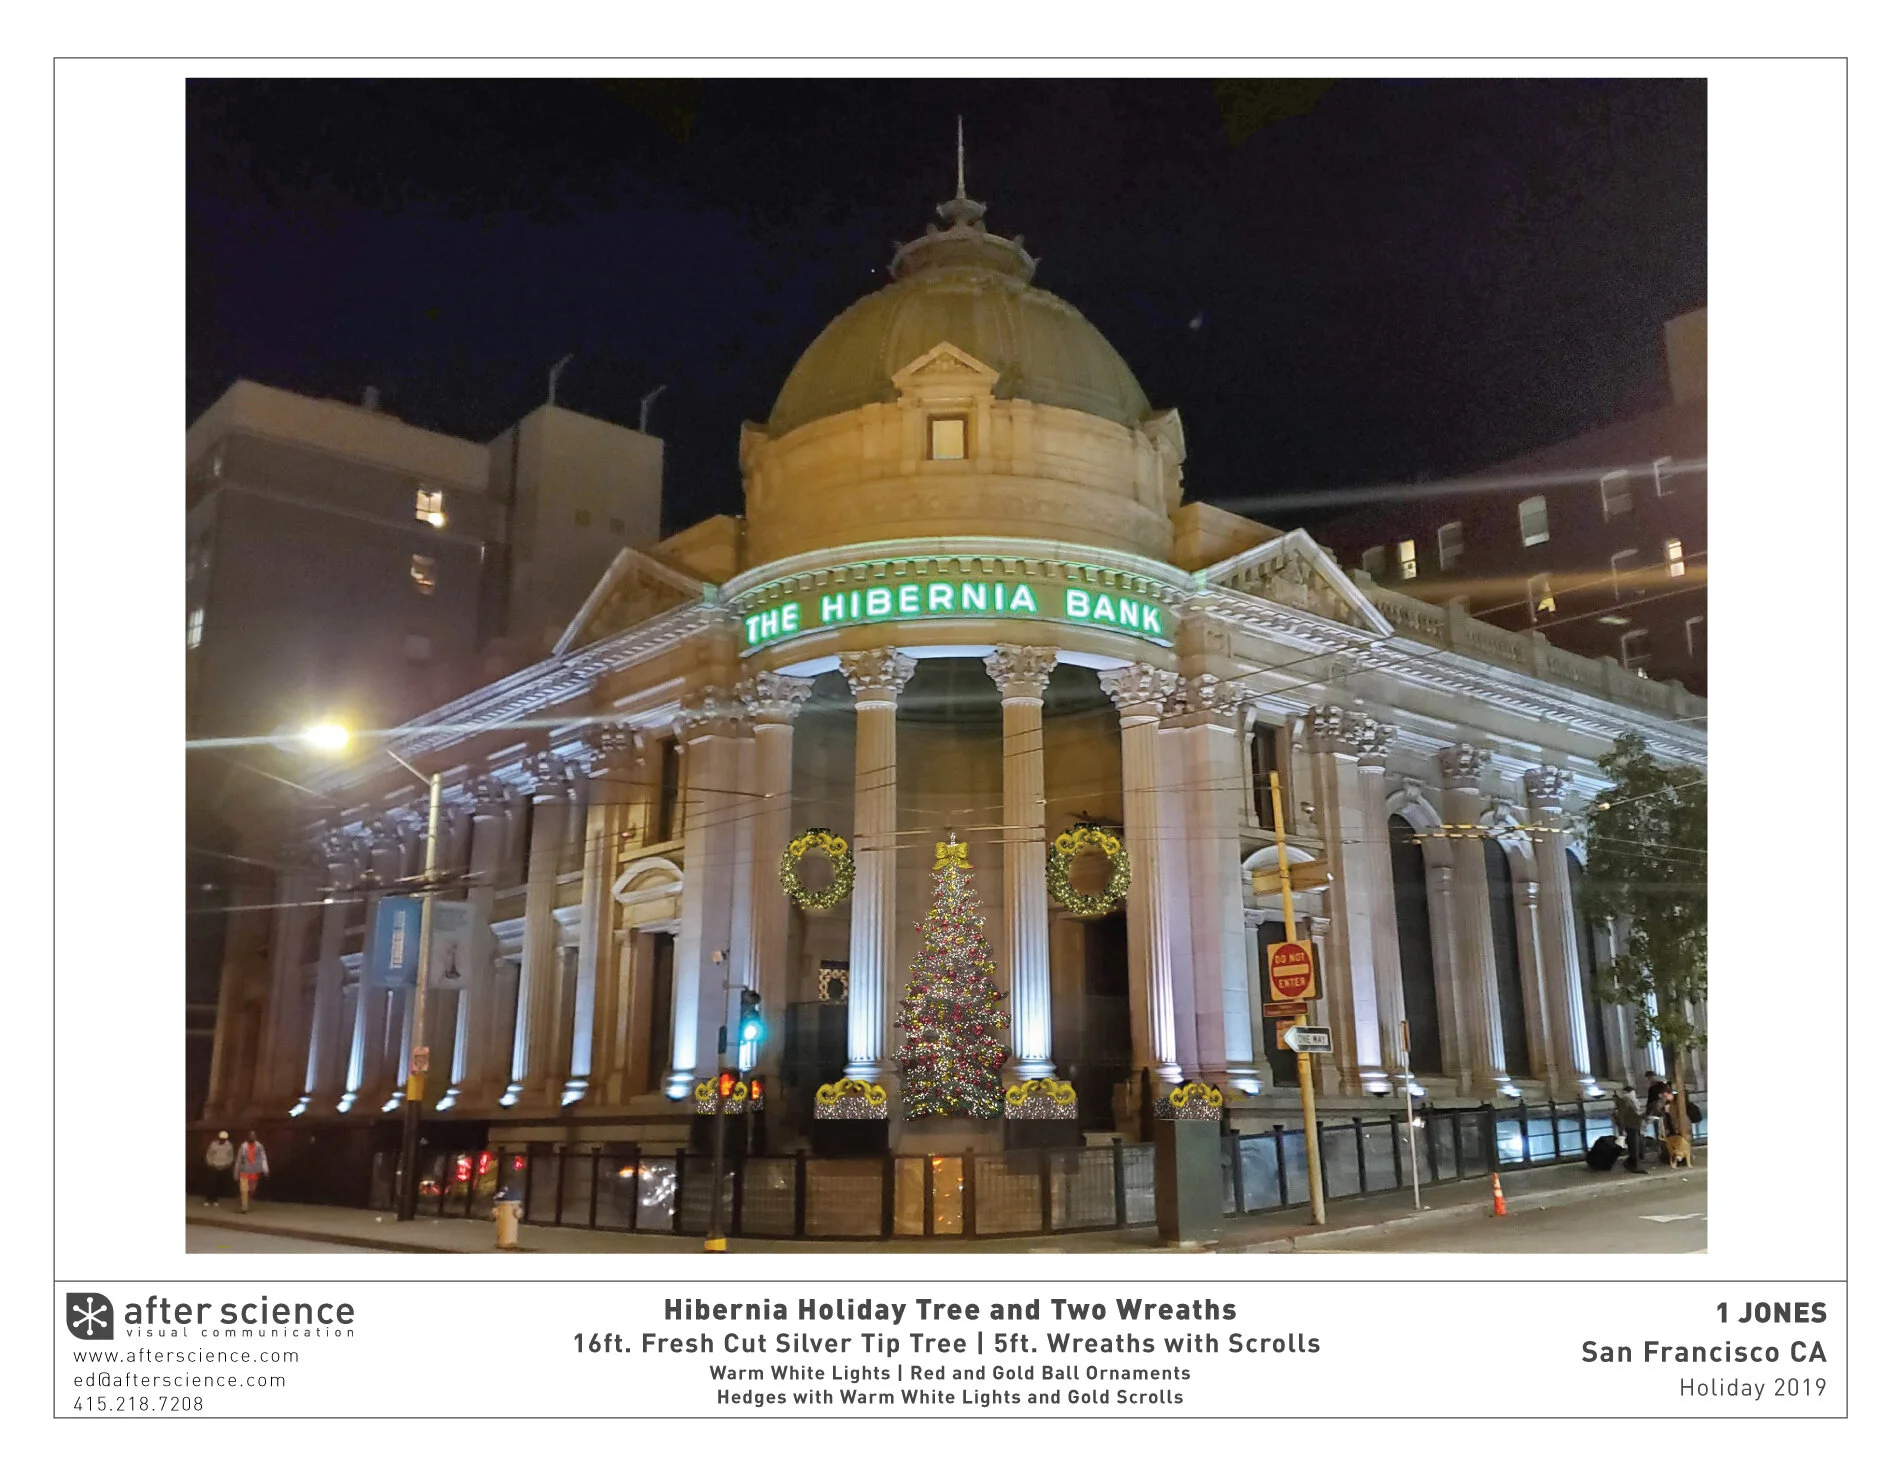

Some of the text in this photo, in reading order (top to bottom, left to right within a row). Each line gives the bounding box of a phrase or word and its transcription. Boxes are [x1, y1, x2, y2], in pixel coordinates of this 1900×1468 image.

[746, 582, 1163, 642] THE HIBERNIA BANK
[1275, 953, 1305, 964] DO NOT
[1279, 978, 1306, 988] ENTER
